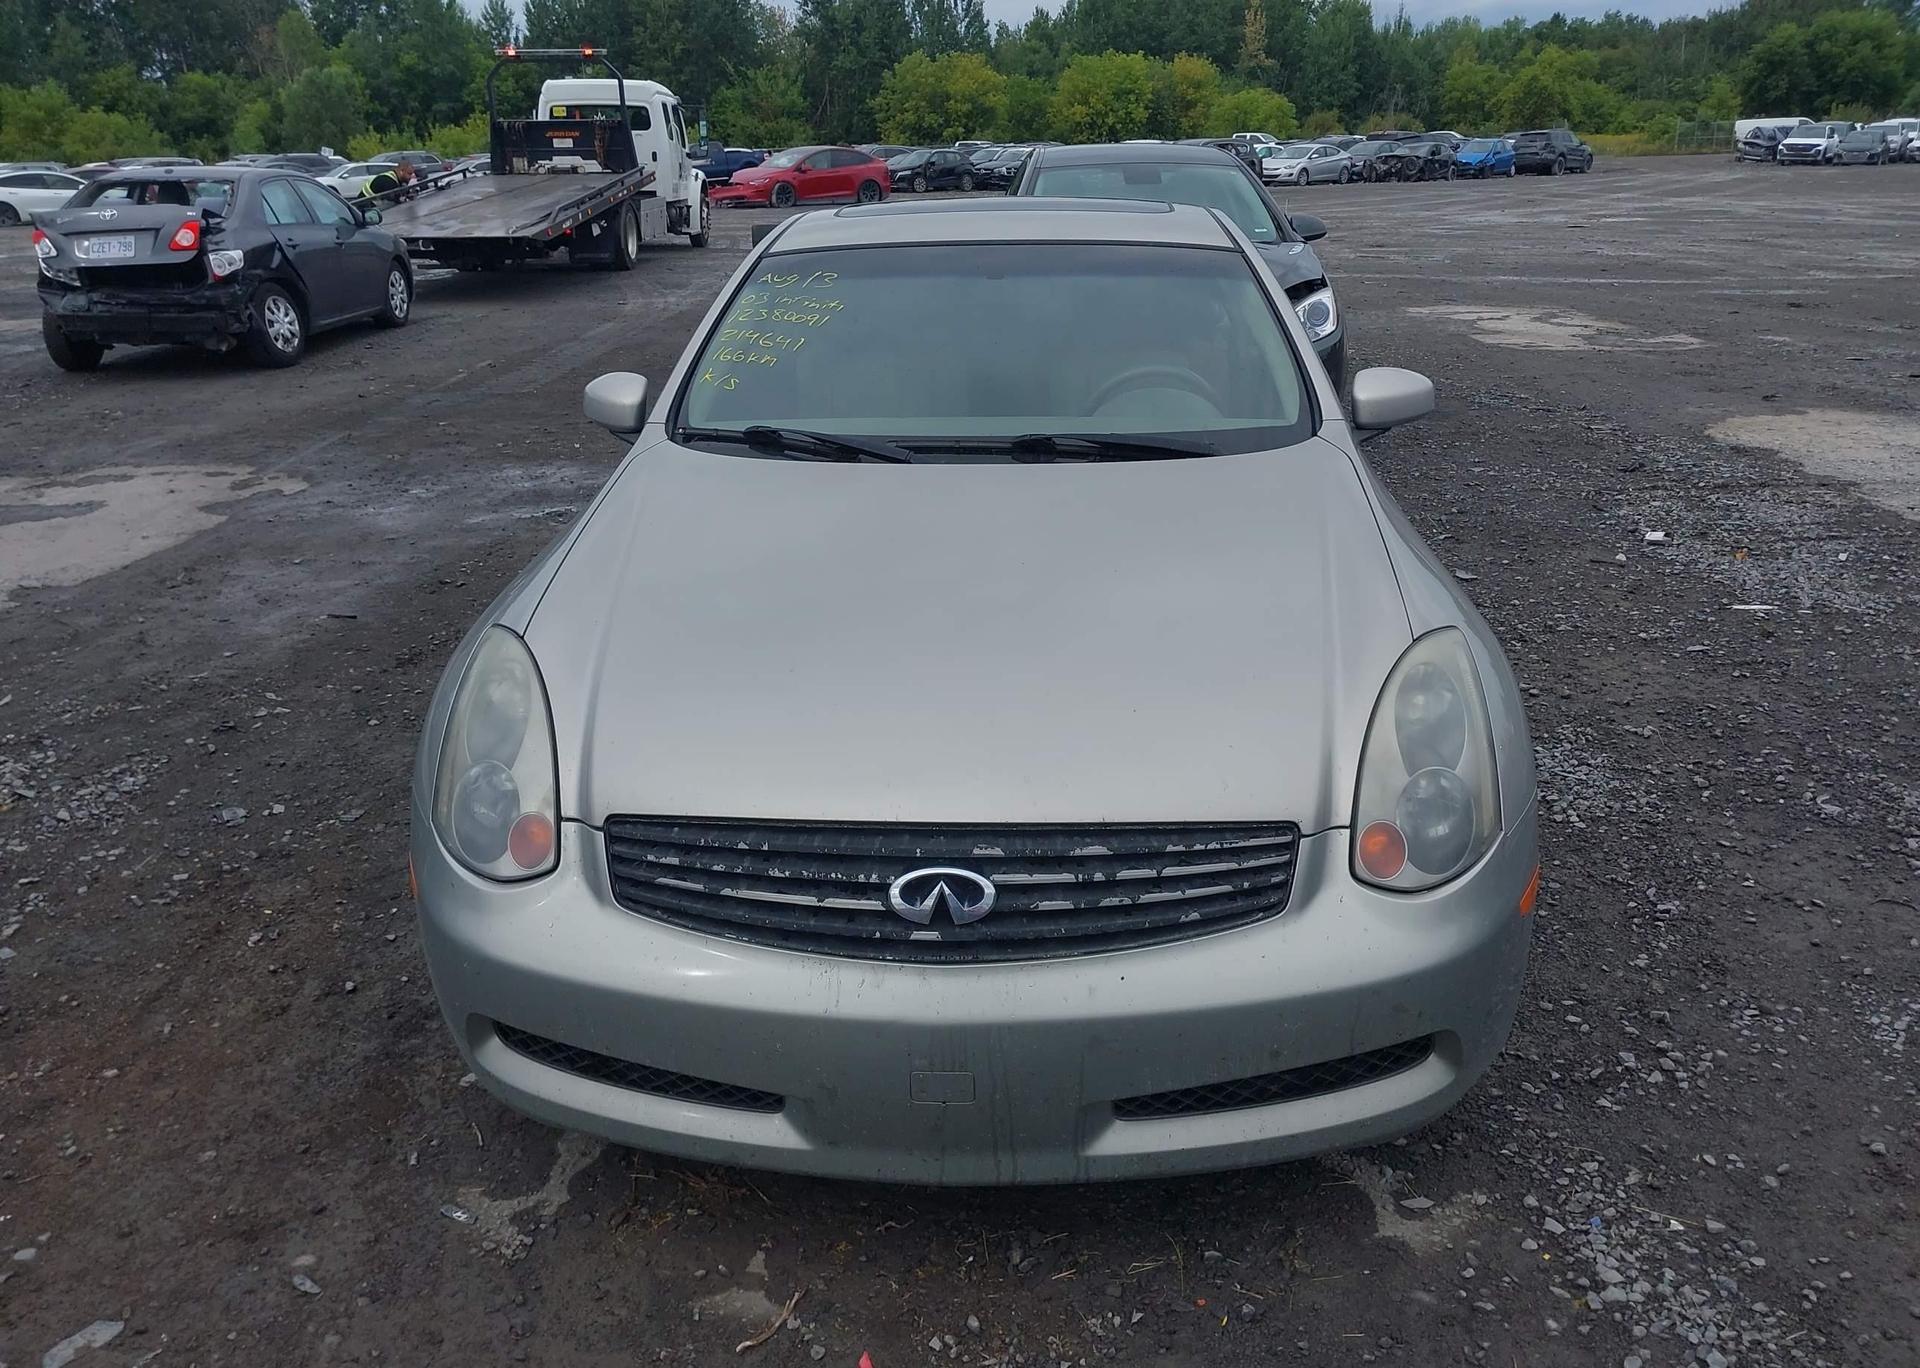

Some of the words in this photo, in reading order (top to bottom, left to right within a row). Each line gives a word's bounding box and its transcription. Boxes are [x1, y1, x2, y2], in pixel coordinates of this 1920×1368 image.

[802, 271, 838, 288] 13
[741, 293, 771, 305] 03
[727, 309, 831, 327] 12380091
